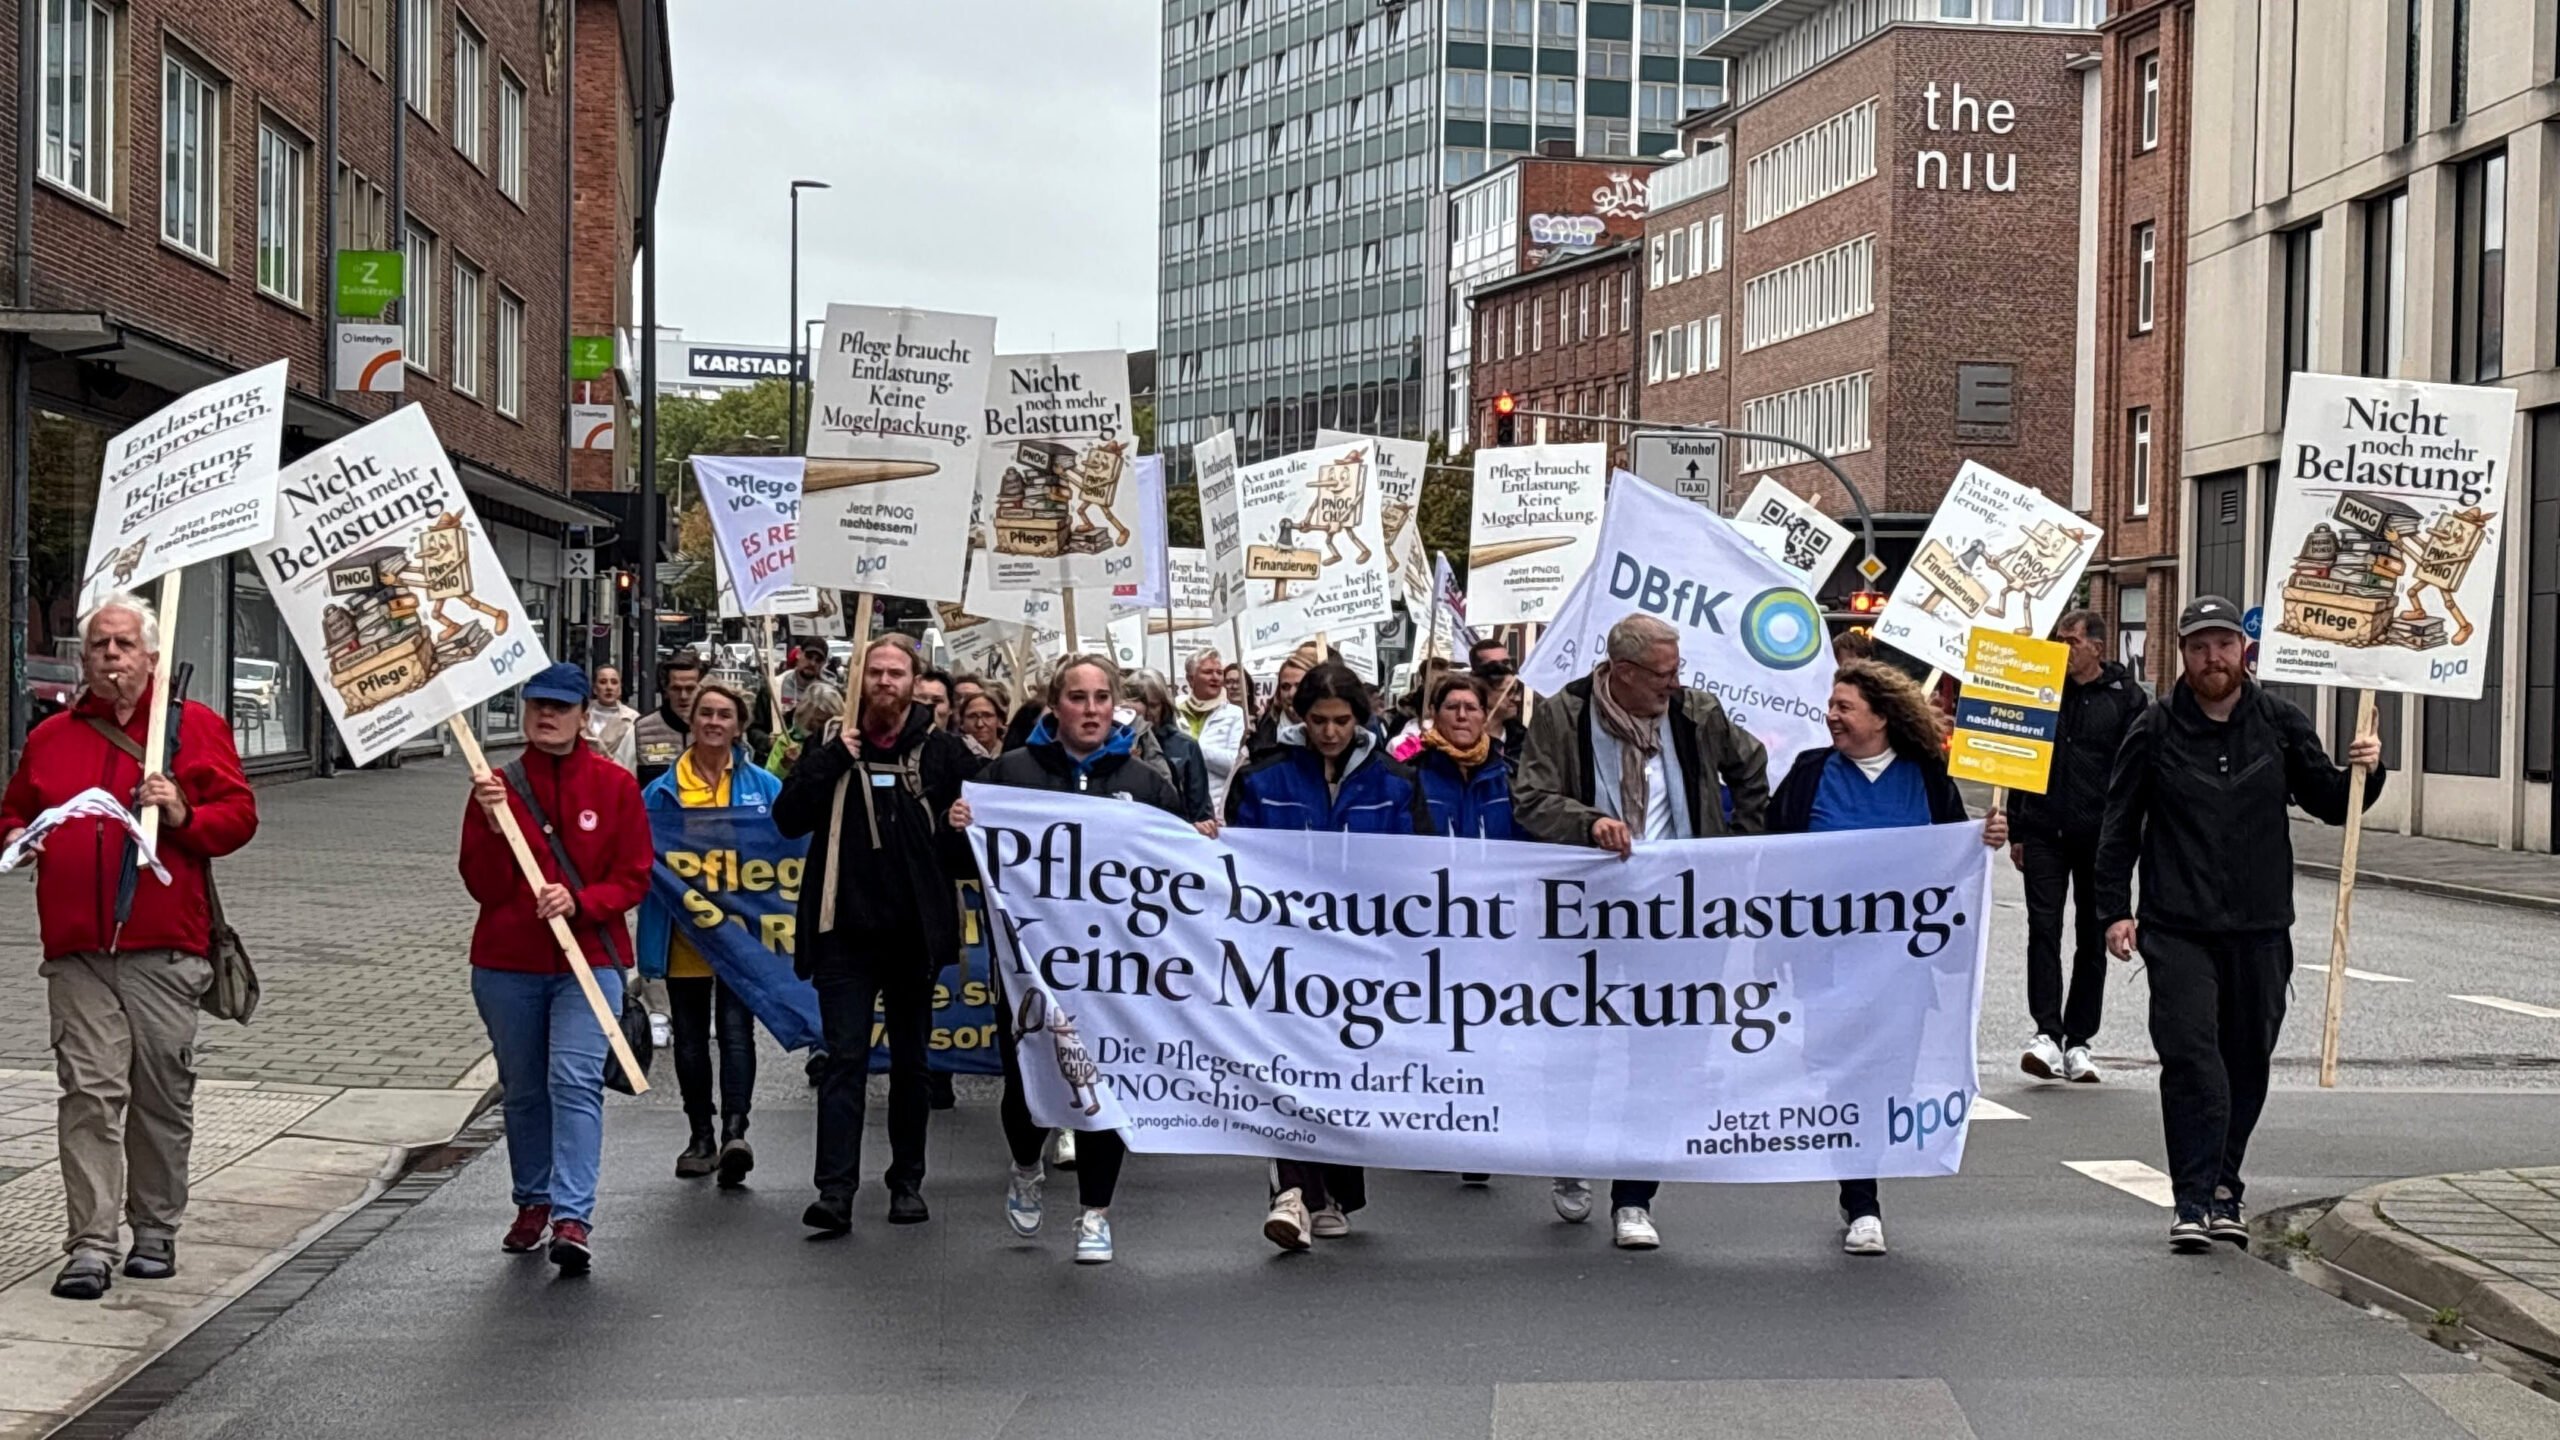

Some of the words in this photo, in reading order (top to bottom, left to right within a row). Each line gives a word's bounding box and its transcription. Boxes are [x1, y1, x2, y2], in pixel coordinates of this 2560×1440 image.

[1923, 80, 2016, 135] the
[1916, 148, 2017, 193] niu
[361, 262, 379, 284] Z
[353, 333, 393, 345] interhyp
[838, 331, 892, 362] Pflege
[894, 334, 971, 364] braucht
[851, 358, 954, 394] Entlastung.
[1009, 363, 1082, 394] Nicht
[868, 384, 926, 409] Keine
[1026, 392, 1062, 412] noch
[1065, 390, 1107, 409] mehr
[123, 386, 263, 460] Entlastung
[821, 405, 972, 446] Mogelpackung.
[984, 403, 1123, 441] Belastung!
[2343, 396, 2449, 437] Nicht
[108, 403, 272, 484] versprochen.
[1670, 442, 1716, 456] Bahnhof
[2361, 435, 2414, 458] noch
[2419, 438, 2479, 463] mehr
[1022, 449, 1047, 465] PNOG
[126, 443, 253, 509] Belastung
[1241, 469, 1266, 485] Axt
[1269, 466, 1285, 478] an
[1288, 458, 1308, 474] die
[1489, 464, 1530, 481] Pflege
[1535, 460, 1591, 476] braucht
[2293, 443, 2496, 506] Belastung!
[120, 459, 242, 535] geliefert?
[281, 452, 382, 519] Nicht
[316, 490, 365, 528] noch
[369, 464, 420, 500] mehr
[1242, 478, 1291, 497] Finanz-
[1501, 478, 1580, 495] Entlastung.
[1680, 482, 1705, 493] TAXI
[1959, 481, 2010, 513] Finanz-
[1965, 471, 1991, 491] Axt
[1993, 485, 2010, 499] an
[2012, 493, 2035, 512] die
[845, 502, 873, 516] Jetzt
[875, 504, 914, 520] PNOG
[1518, 494, 1562, 507] Keine
[169, 516, 206, 537] Jetzt
[210, 499, 260, 521] PNOG
[266, 467, 450, 584] Belastung!
[840, 517, 917, 535] nachbessern!
[1481, 506, 1598, 528] Mogelpackung.
[2342, 503, 2378, 528] PNOG
[741, 532, 762, 559] ES
[767, 523, 800, 546] RE
[1010, 531, 1048, 546] Pflege
[336, 568, 370, 588] PNOG
[856, 555, 887, 576] bpa
[1105, 556, 1133, 576] bpa
[1253, 556, 1318, 576] Finanzierung
[1345, 568, 1381, 588] heißt
[1314, 591, 1339, 606] Axt
[1343, 587, 1360, 600] an
[1363, 581, 1383, 595] die
[1608, 551, 1733, 635] DBfK
[1922, 552, 1980, 613] Finanzierung
[1024, 599, 1049, 616] bpa
[1303, 593, 1385, 618] Versorgung!
[1521, 597, 1544, 613] bpa
[1256, 621, 1280, 641] bpa
[1881, 620, 1911, 637] bpa
[2303, 606, 2358, 631] Pflege
[489, 639, 526, 676] bpa
[2301, 648, 2330, 659] PNOG
[357, 664, 409, 696] Pflege
[2429, 659, 2469, 683] bpa
[1966, 714, 2045, 737] nachbessern!
[1990, 706, 2025, 721] PNOG
[984, 820, 1205, 938] Pflege
[1217, 854, 1515, 939] braucht
[1538, 869, 1967, 958] Entlastung.
[1215, 938, 1792, 1054] Mogelpackung.
[1097, 1036, 1147, 1064] Die
[1155, 1039, 1341, 1093] Pflegereform
[1351, 1060, 1418, 1094] darf
[1422, 1061, 1484, 1096] kein
[1379, 1105, 1499, 1133] werden!
[1708, 1108, 1770, 1133] Jetzt
[1779, 1103, 1860, 1130] PNOG
[1887, 1088, 1967, 1151] bpa
[1685, 1130, 1861, 1156] nachbessern.
